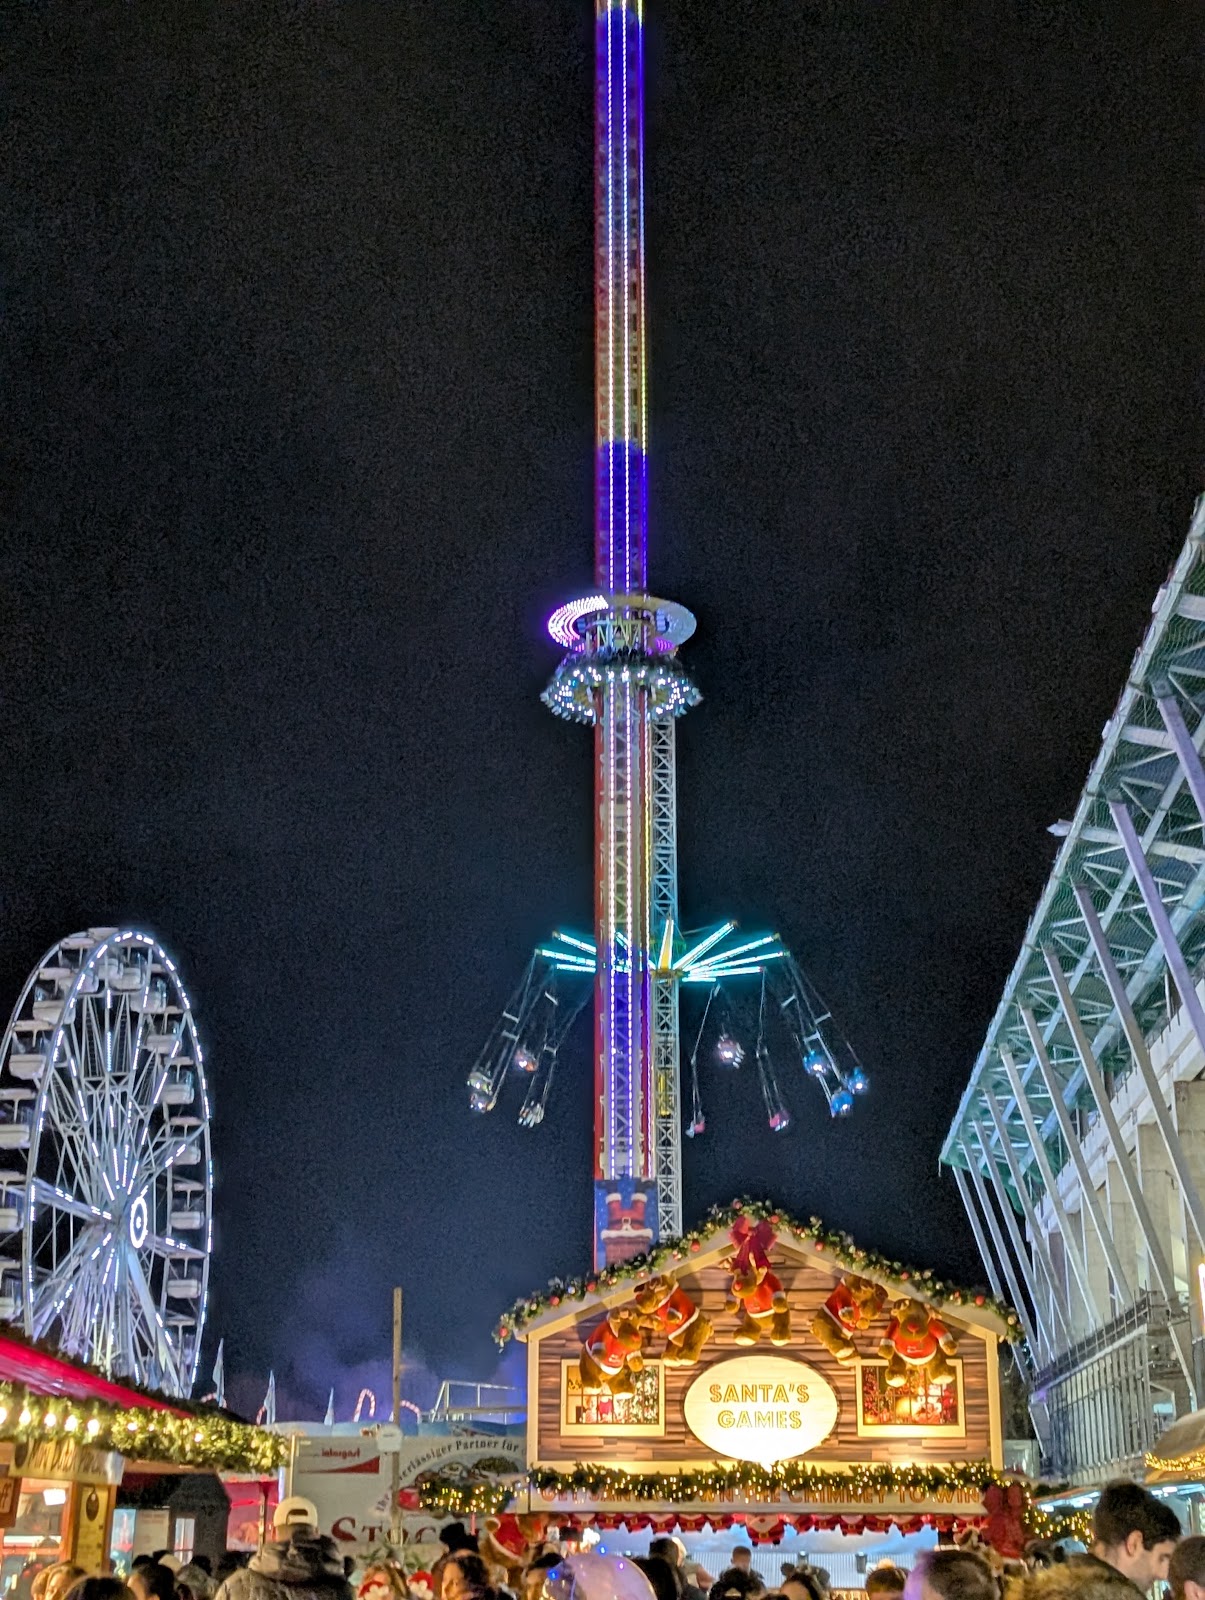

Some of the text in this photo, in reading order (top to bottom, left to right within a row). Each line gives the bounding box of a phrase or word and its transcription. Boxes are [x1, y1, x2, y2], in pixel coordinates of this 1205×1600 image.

[709, 1383, 810, 1403] SANTA'S
[717, 1410, 802, 1429] GAMES
[456, 1440, 498, 1451] Partner
[789, 1486, 886, 1504] CHIMNEY
[899, 1487, 925, 1504] TO
[936, 1487, 980, 1504] WIN
